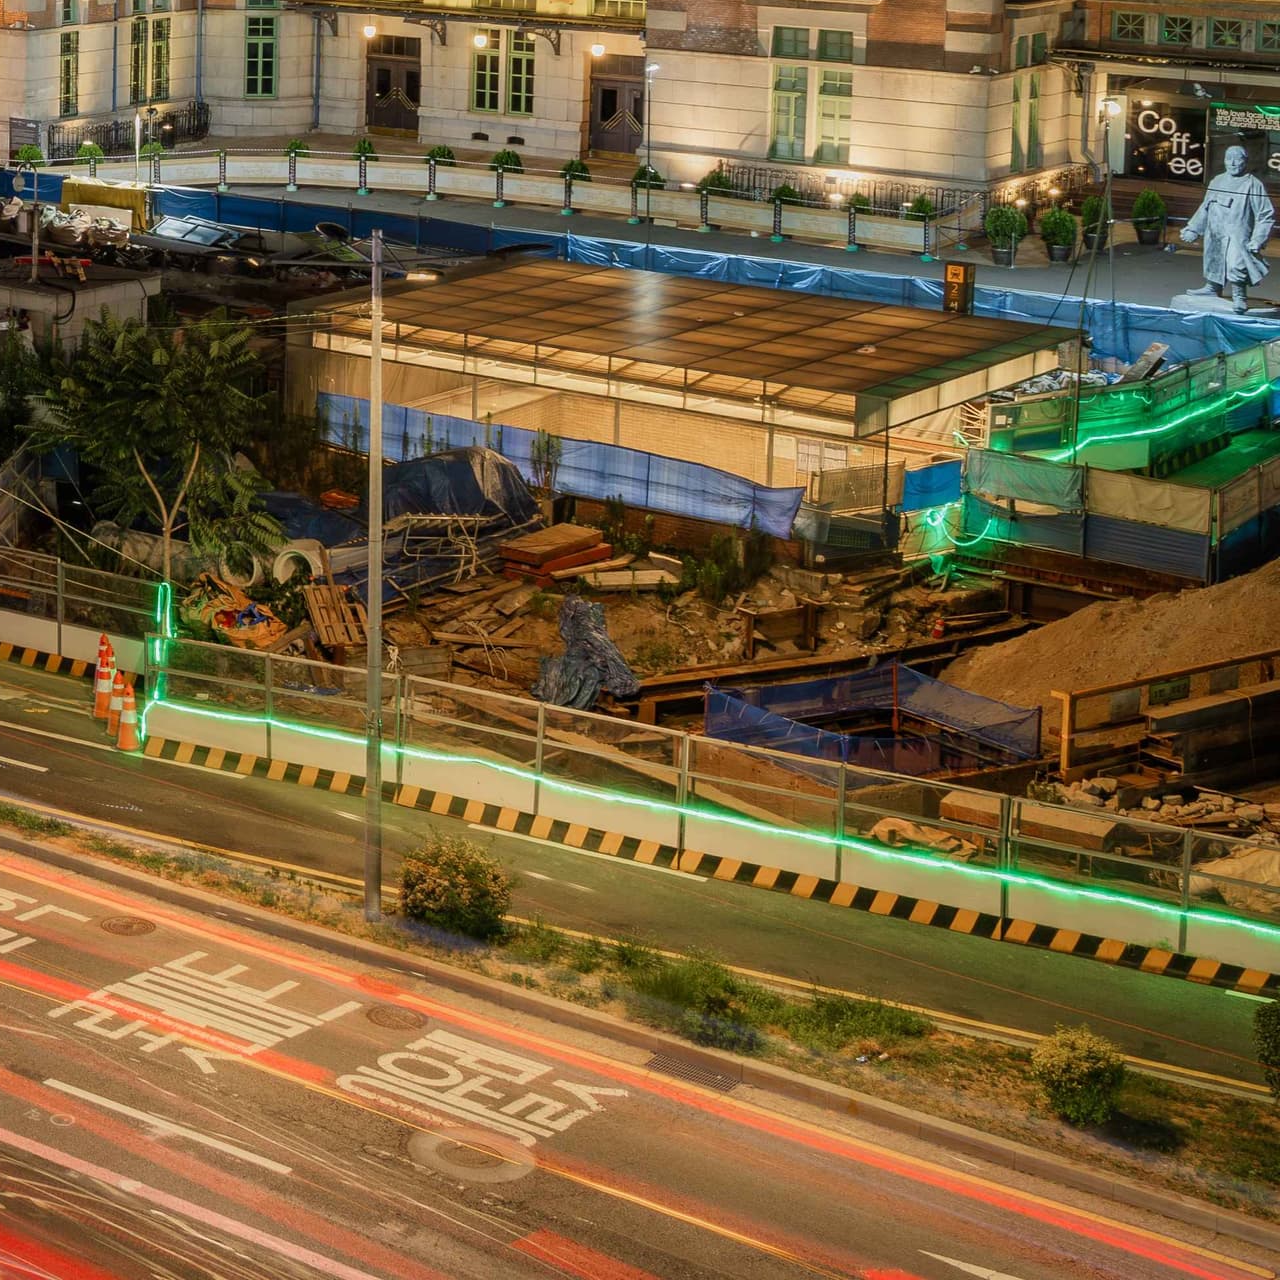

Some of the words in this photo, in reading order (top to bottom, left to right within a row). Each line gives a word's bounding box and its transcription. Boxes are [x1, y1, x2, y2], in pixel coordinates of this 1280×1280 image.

[1216, 108, 1229, 117] We
[1230, 109, 1245, 118] love
[1231, 116, 1266, 126] introduce
[1168, 157, 1203, 176] ee
[951, 283, 959, 293] 2
[47, 950, 364, 1075] 롯데마트
[336, 1028, 631, 1149] 아울렛
